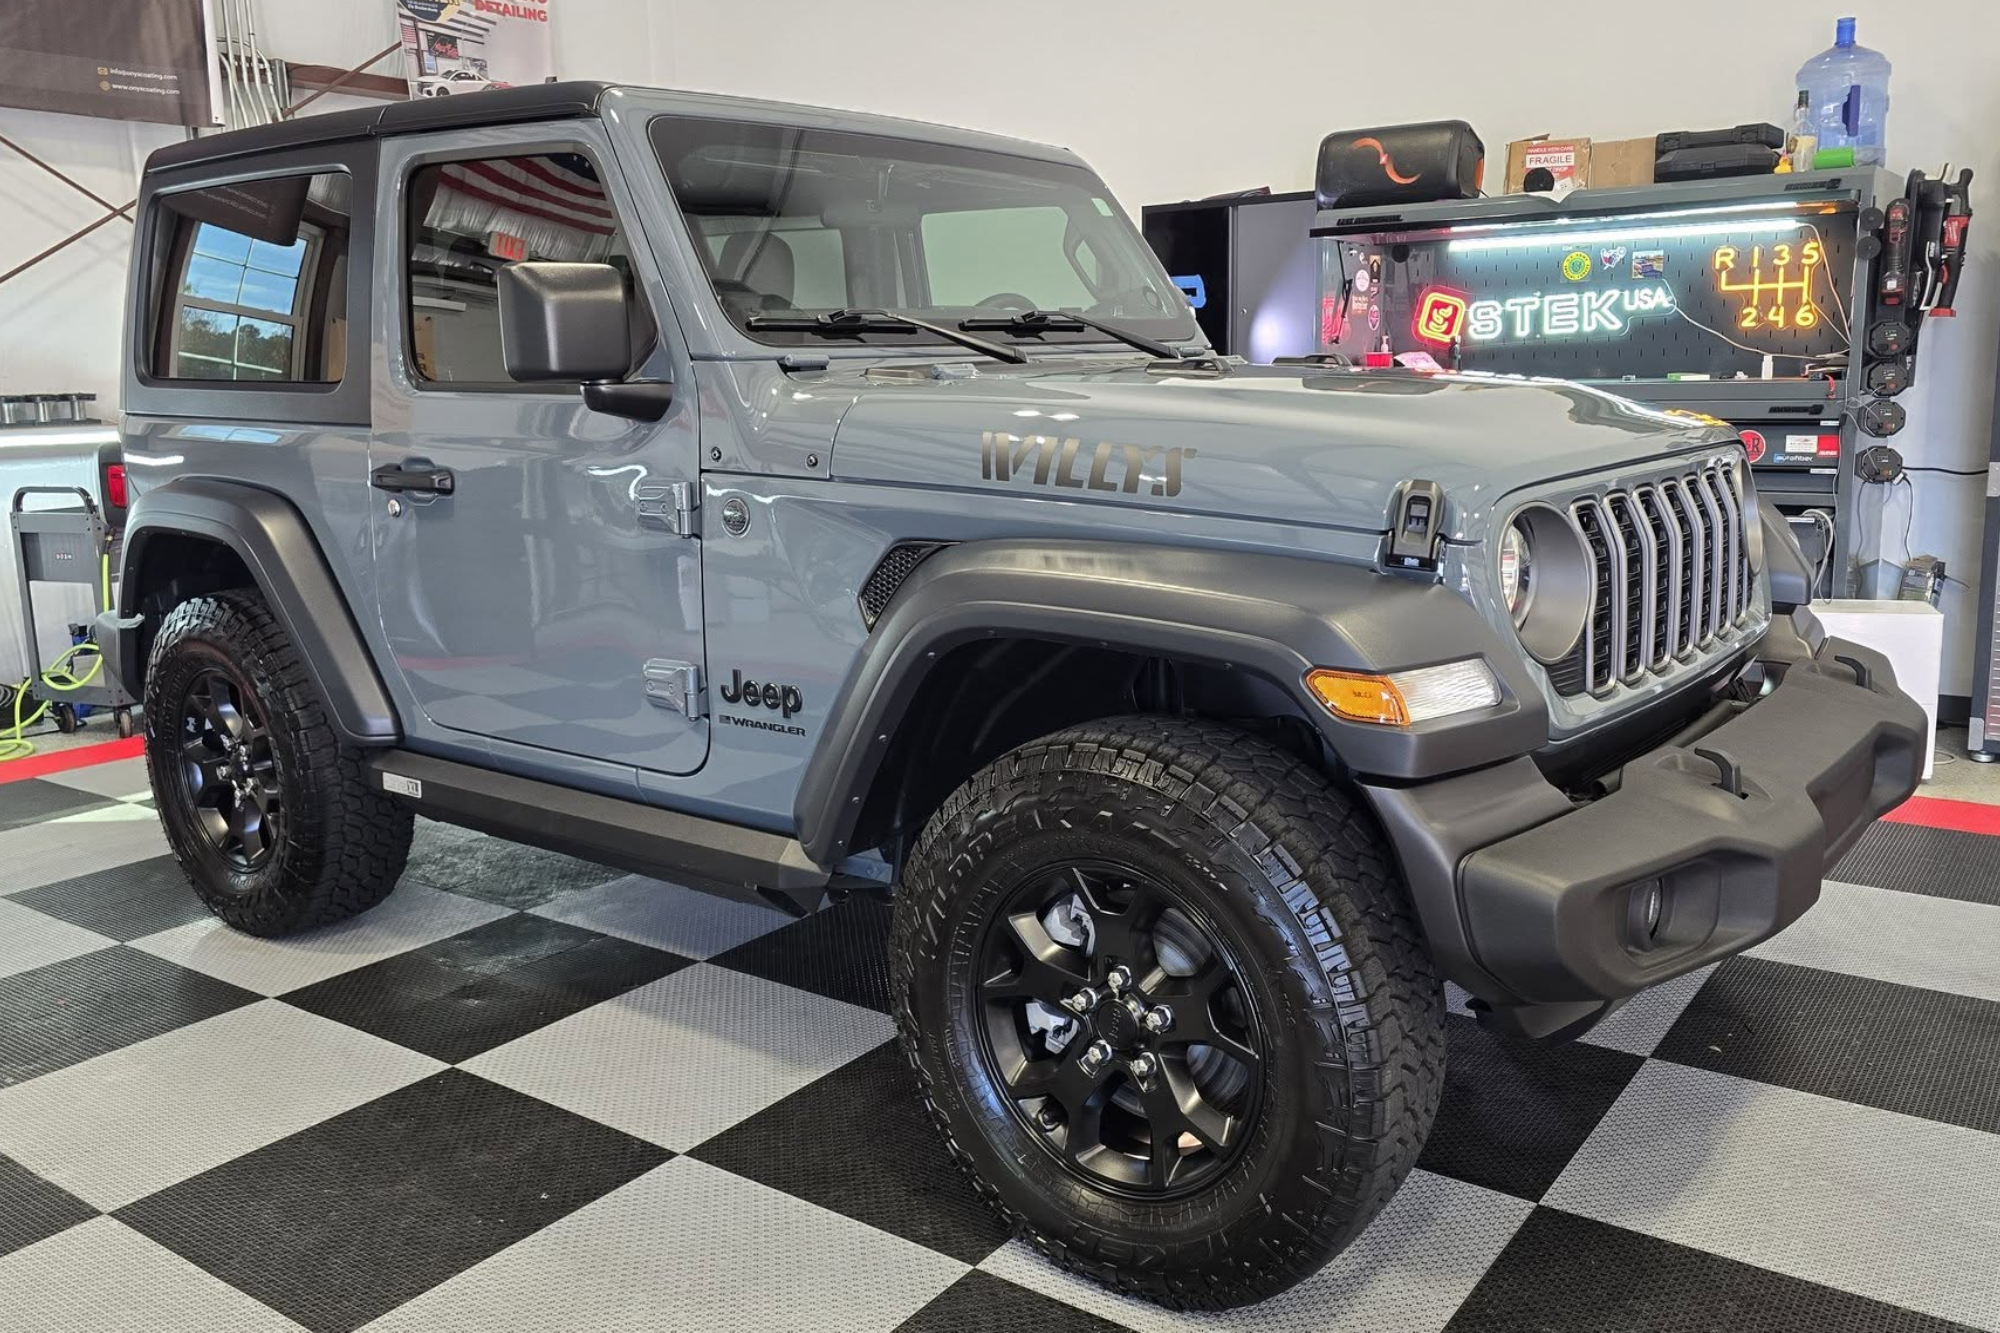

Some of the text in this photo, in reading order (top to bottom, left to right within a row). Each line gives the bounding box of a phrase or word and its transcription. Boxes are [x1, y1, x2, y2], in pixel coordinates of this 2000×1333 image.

[474, 0, 548, 22] DETAILING
[111, 83, 180, 95] www.onyxcoating.com
[1529, 154, 1573, 166] FRAGILE
[1714, 247, 1735, 270] R
[1773, 244, 1791, 266] 3
[1801, 241, 1820, 265] 5
[1467, 287, 1669, 340] STEK USA
[1741, 304, 1815, 328] 2 4 6
[981, 431, 1198, 498] WILLYS
[720, 669, 803, 719] Jeep
[731, 716, 807, 737] WRANGLER
